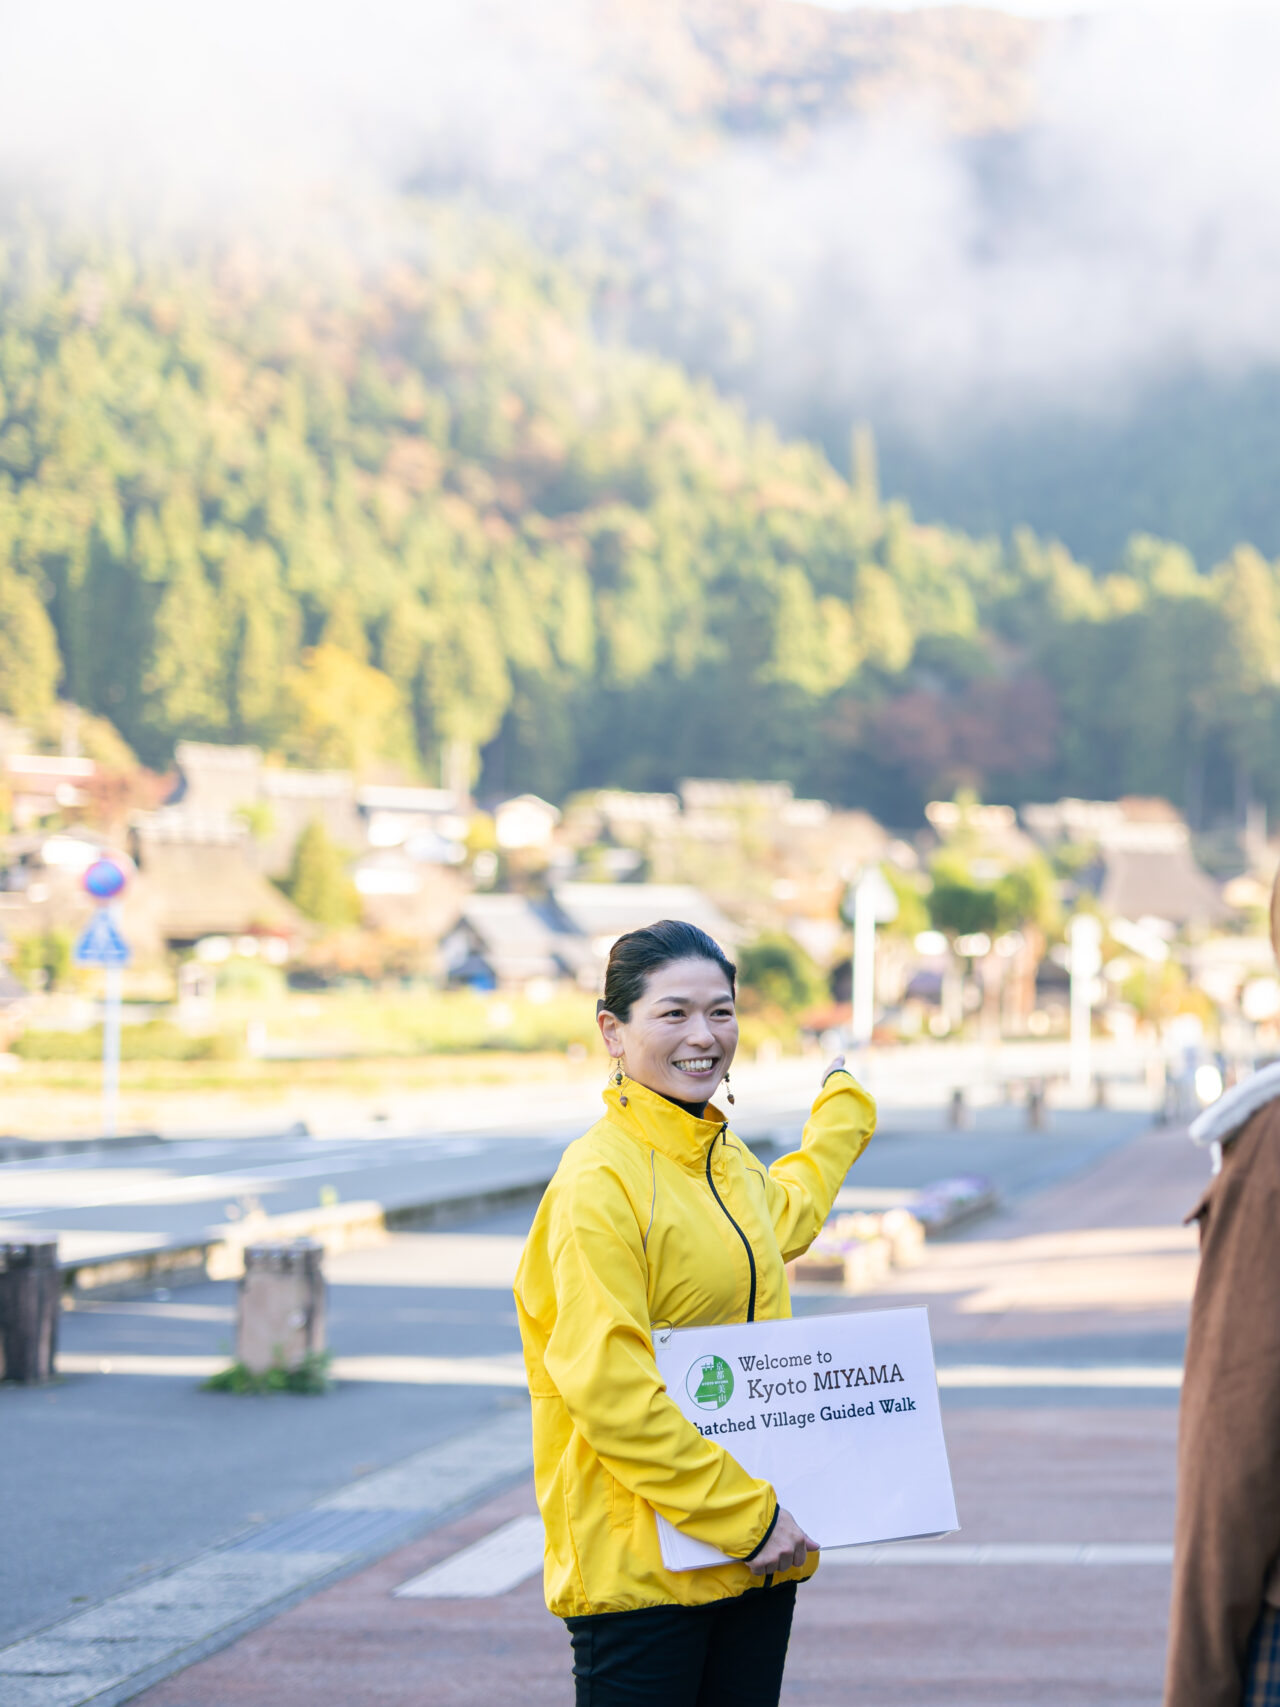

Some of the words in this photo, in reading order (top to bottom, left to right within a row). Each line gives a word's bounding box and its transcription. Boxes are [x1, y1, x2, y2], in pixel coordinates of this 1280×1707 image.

[738, 1354, 812, 1372] Welcome
[816, 1350, 833, 1364] to
[747, 1378, 808, 1404] Kyoto
[813, 1363, 905, 1392] MIYAMA
[692, 1415, 757, 1436] hatched
[760, 1411, 816, 1429] Village
[820, 1401, 876, 1421] Guided
[878, 1396, 917, 1414] Walk
